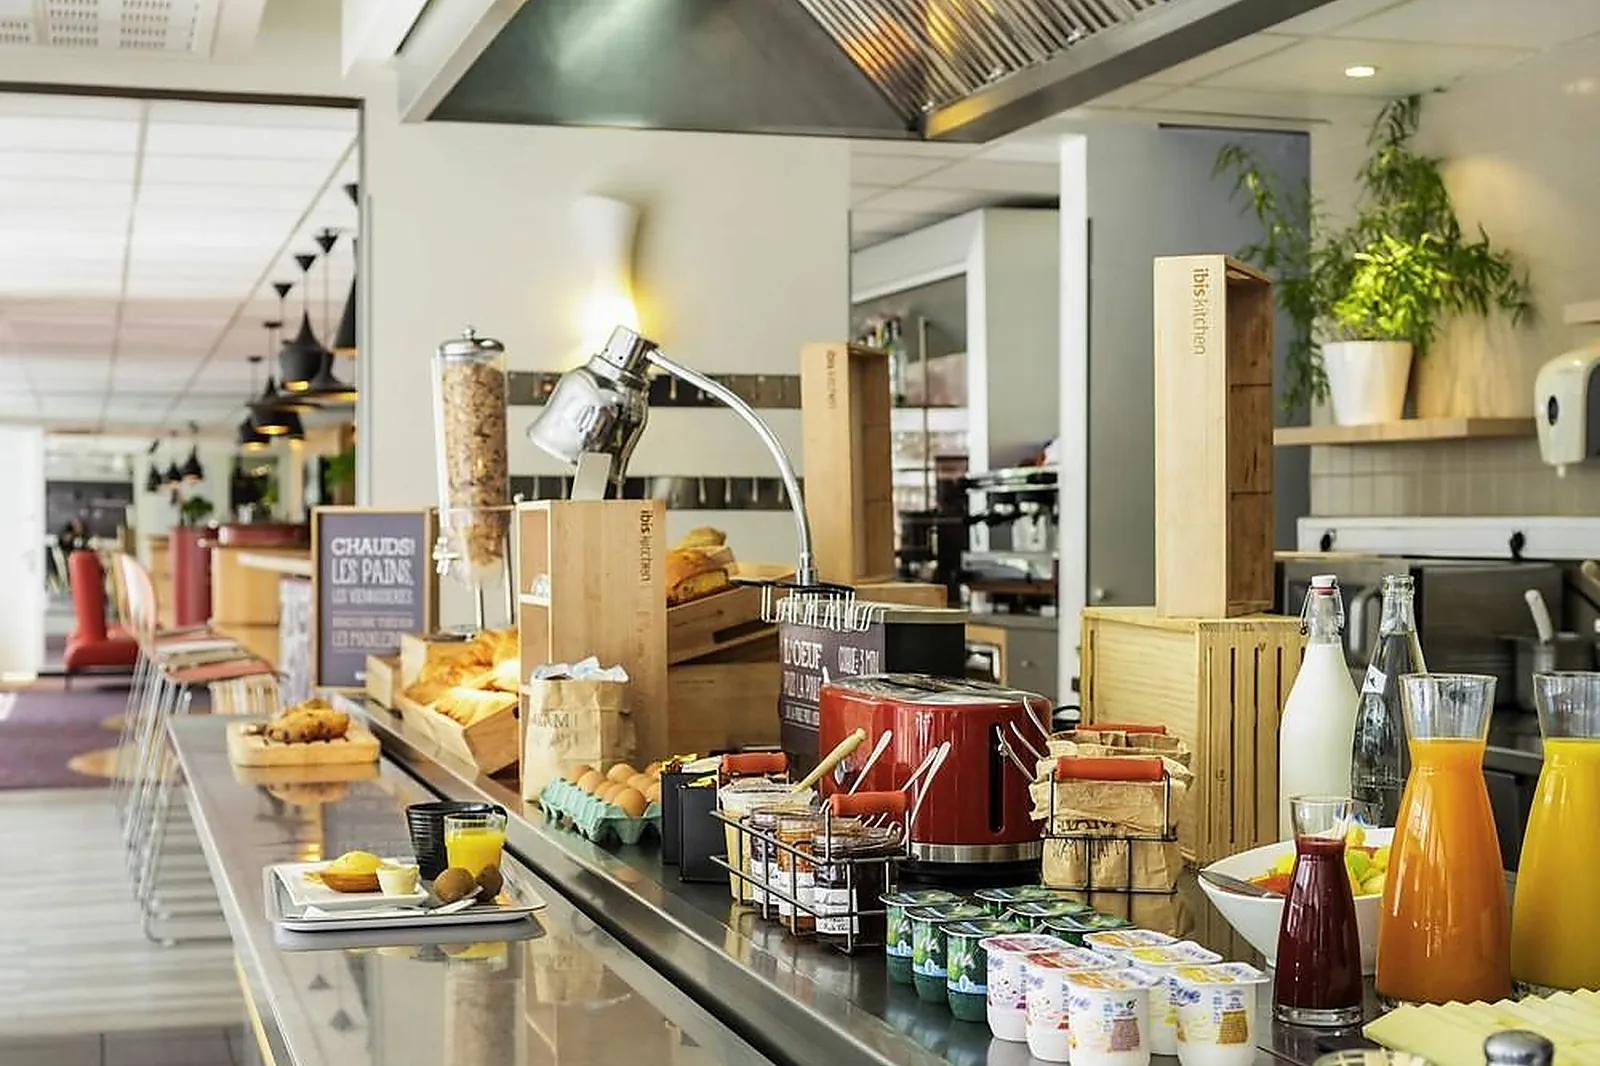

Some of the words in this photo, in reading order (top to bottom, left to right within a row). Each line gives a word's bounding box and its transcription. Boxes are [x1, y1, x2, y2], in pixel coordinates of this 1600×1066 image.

[1193, 267, 1209, 297] ibis
[640, 509, 654, 534] ibis
[332, 558, 358, 584] LES
[783, 637, 823, 670] L'OEUF
